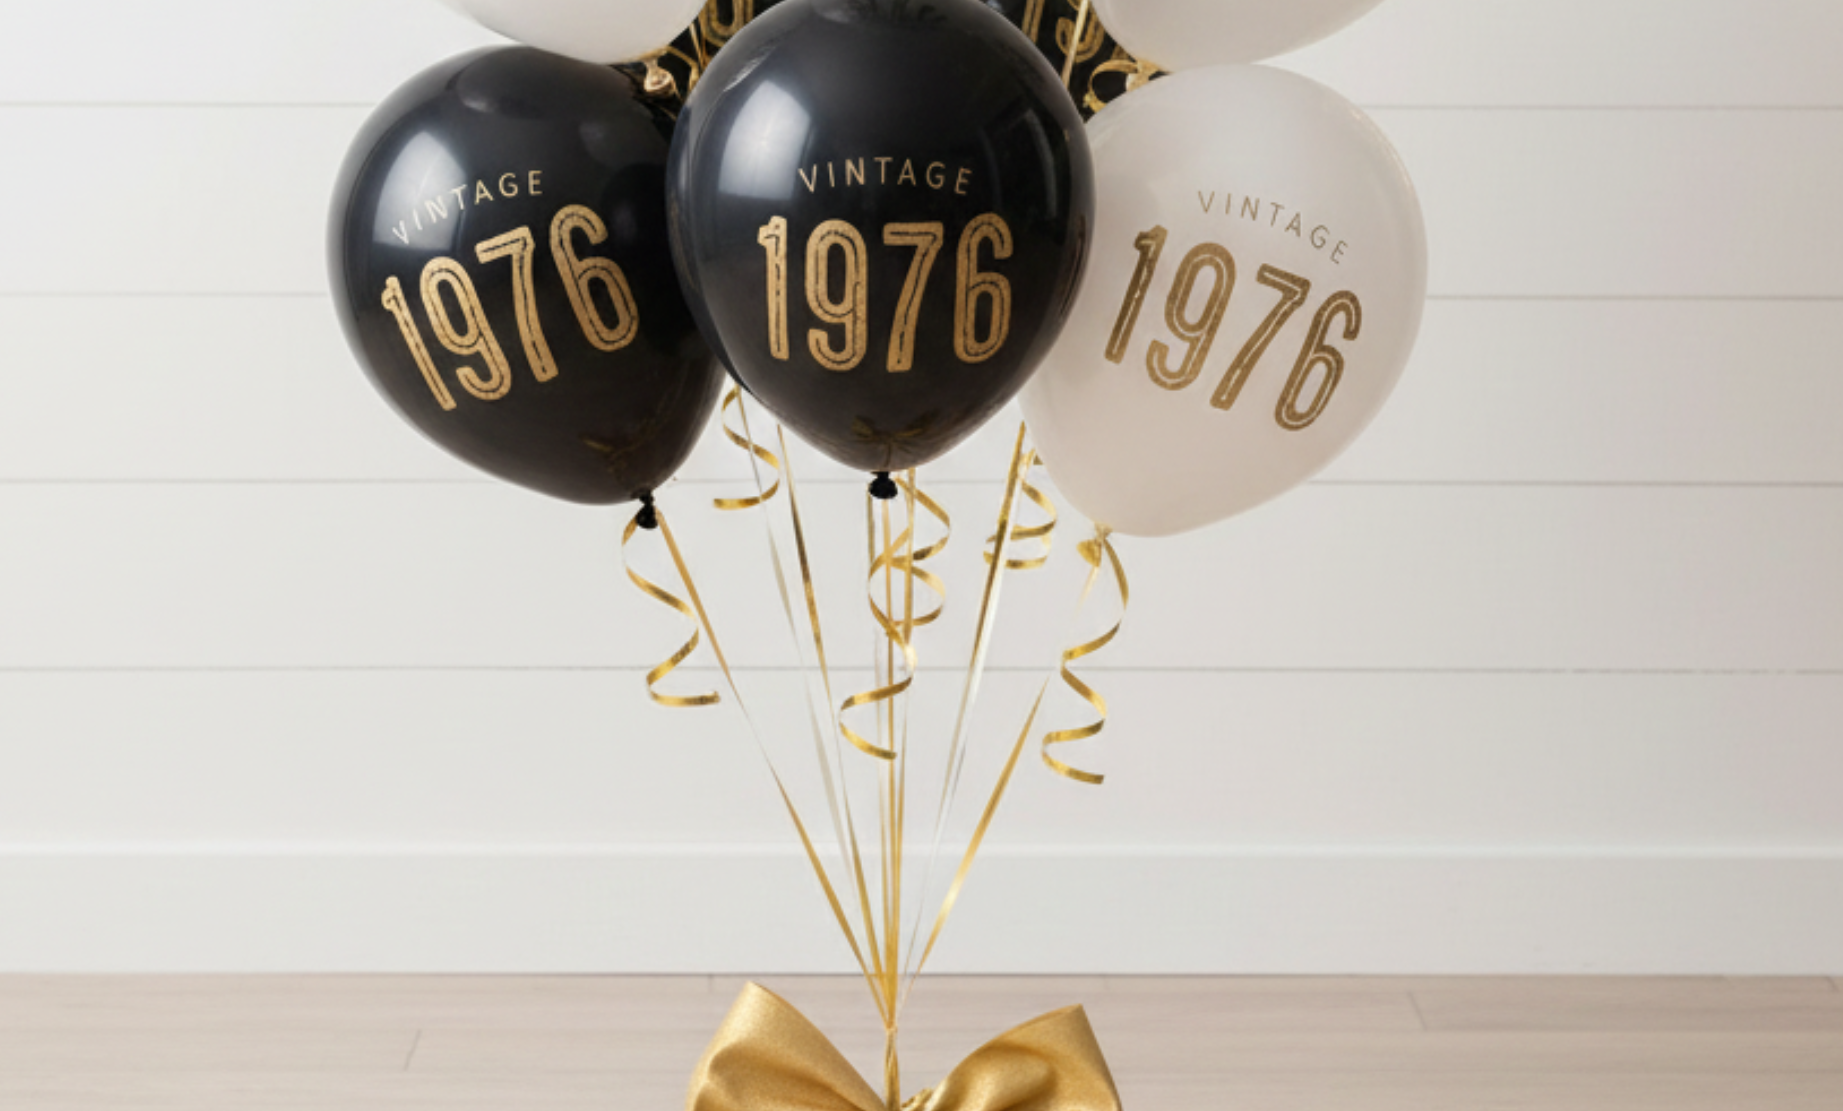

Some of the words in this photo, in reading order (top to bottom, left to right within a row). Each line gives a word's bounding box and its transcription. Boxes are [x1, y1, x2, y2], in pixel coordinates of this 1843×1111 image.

[392, 170, 543, 245] VINTAGE
[798, 157, 972, 195] VINTAGE
[1198, 190, 1348, 265] VINTAGE
[381, 204, 639, 411] 1976
[757, 212, 1013, 372] 1976
[1105, 224, 1362, 431] 1976
